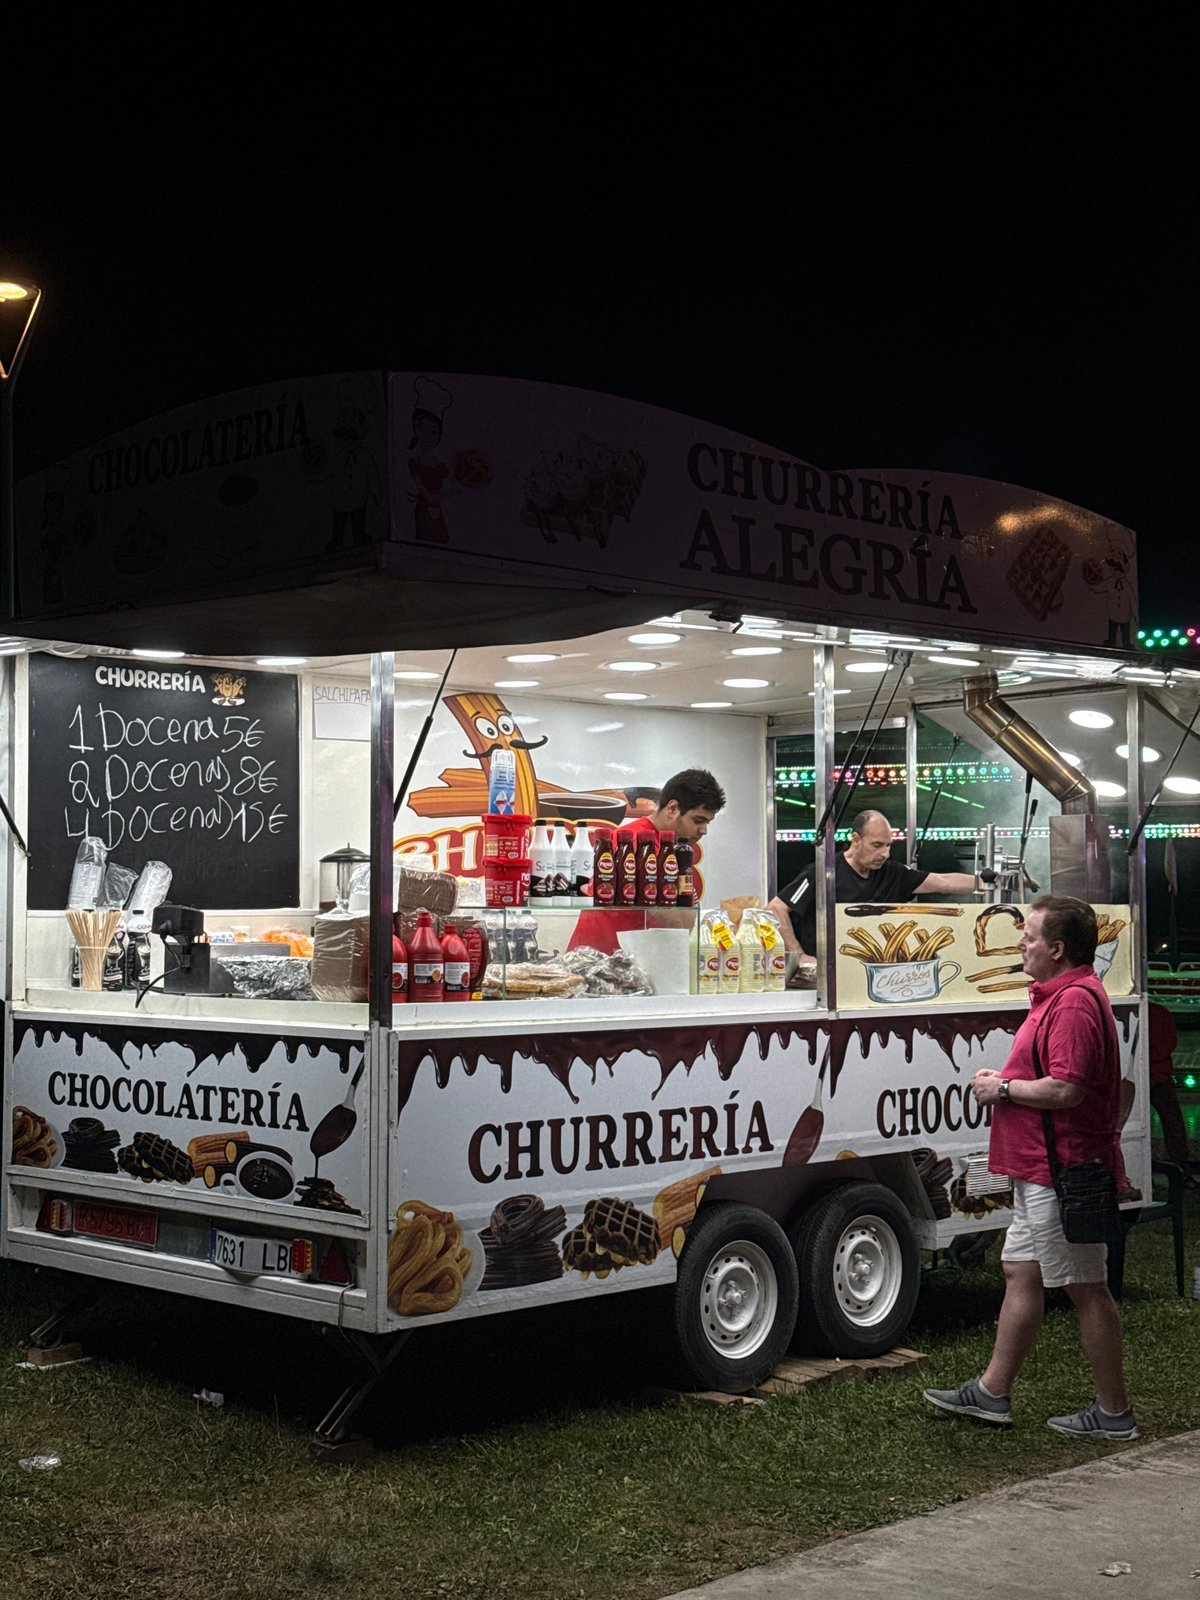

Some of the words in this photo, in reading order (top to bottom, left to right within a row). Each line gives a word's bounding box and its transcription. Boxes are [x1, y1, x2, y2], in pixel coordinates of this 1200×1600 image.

[88, 392, 306, 495] CHOCOLATERÍA
[687, 442, 964, 540] CHURRERÍA
[679, 509, 978, 613] ALEGRÍA
[95, 665, 206, 693] CHURRERÍA
[69, 704, 94, 754] 1
[221, 715, 265, 753] 5€
[69, 760, 99, 808] 2
[232, 756, 279, 796] 8€
[65, 807, 89, 838] 4
[48, 1070, 310, 1132] CHOCOLATERÍA
[469, 1090, 775, 1184] CHURRERÍA
[217, 1235, 245, 1268] 7631
